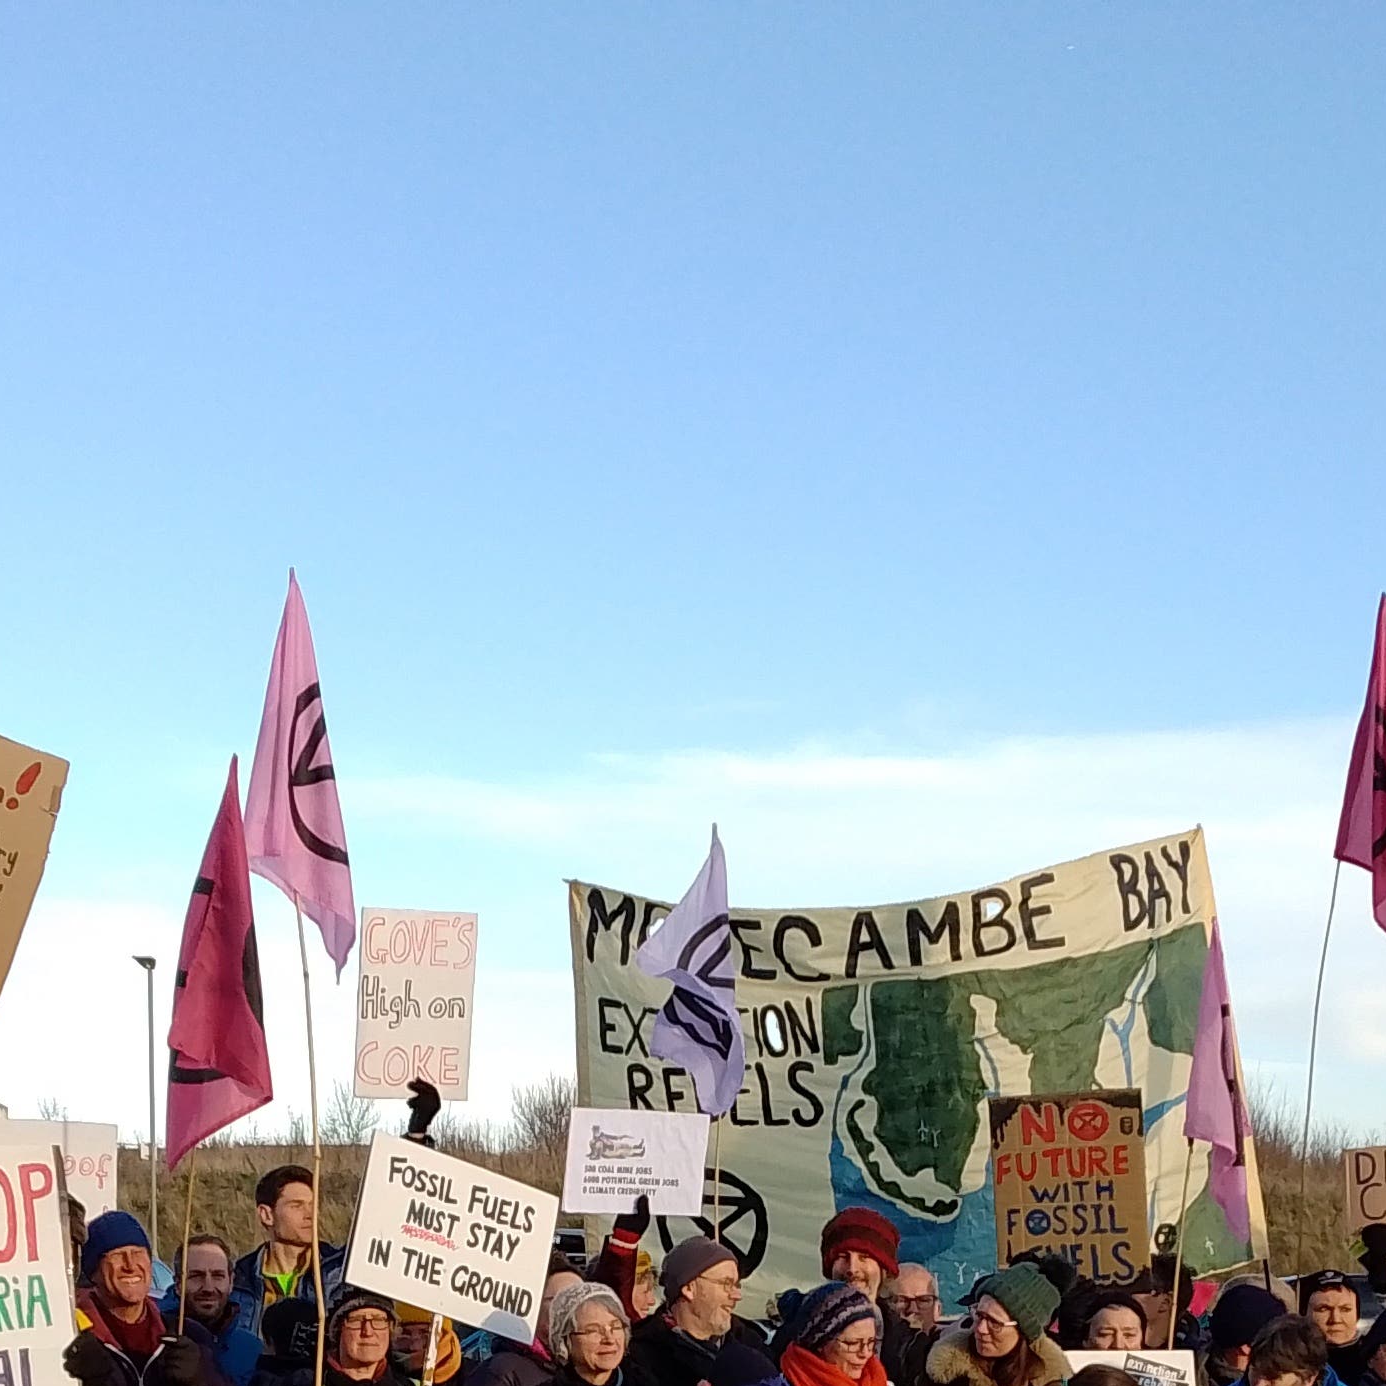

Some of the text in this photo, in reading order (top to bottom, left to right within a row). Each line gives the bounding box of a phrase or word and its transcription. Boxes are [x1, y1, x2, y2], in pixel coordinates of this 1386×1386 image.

[1109, 839, 1192, 932] BAY
[364, 916, 474, 969] GOVE'S
[360, 975, 465, 1029] High on
[357, 1040, 461, 1086] COKE
[1020, 1103, 1109, 1145] NO
[996, 1145, 1129, 1185] FUTURE
[1028, 1180, 1115, 1203] WITH
[389, 1156, 536, 1234] FOSSIL FUELS
[1007, 1203, 1128, 1236] FOSSIL
[406, 1198, 460, 1241] MUST
[466, 1222, 520, 1264] STAY
[367, 1238, 392, 1269] IN
[401, 1246, 444, 1286] THE
[450, 1265, 533, 1318] GROUND
